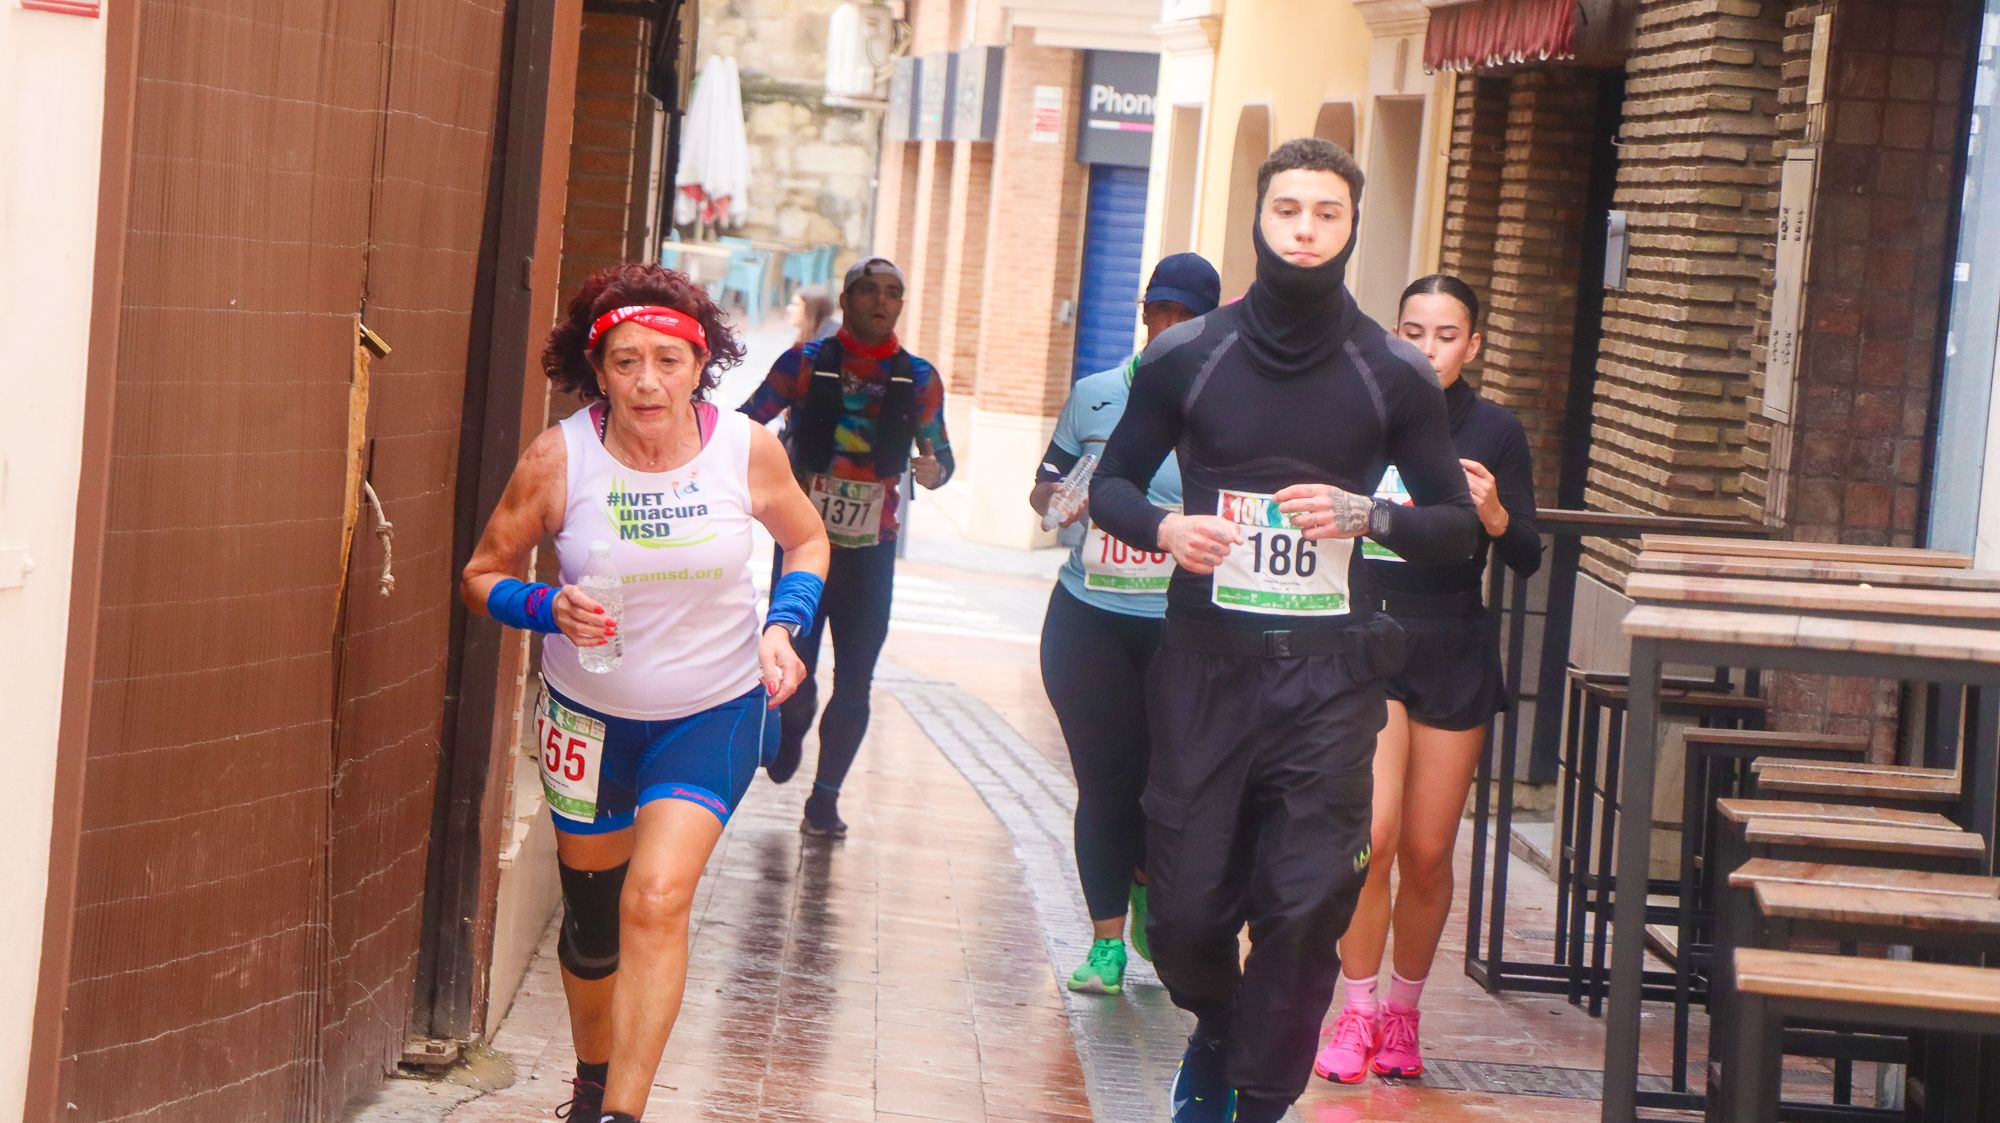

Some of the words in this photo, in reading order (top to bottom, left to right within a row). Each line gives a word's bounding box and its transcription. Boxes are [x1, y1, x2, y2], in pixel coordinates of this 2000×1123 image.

[1090, 83, 1156, 115] Phon
[607, 492, 665, 507] #IVET
[620, 504, 708, 522] unacura
[620, 522, 671, 541] MSD
[1247, 532, 1317, 577] 186
